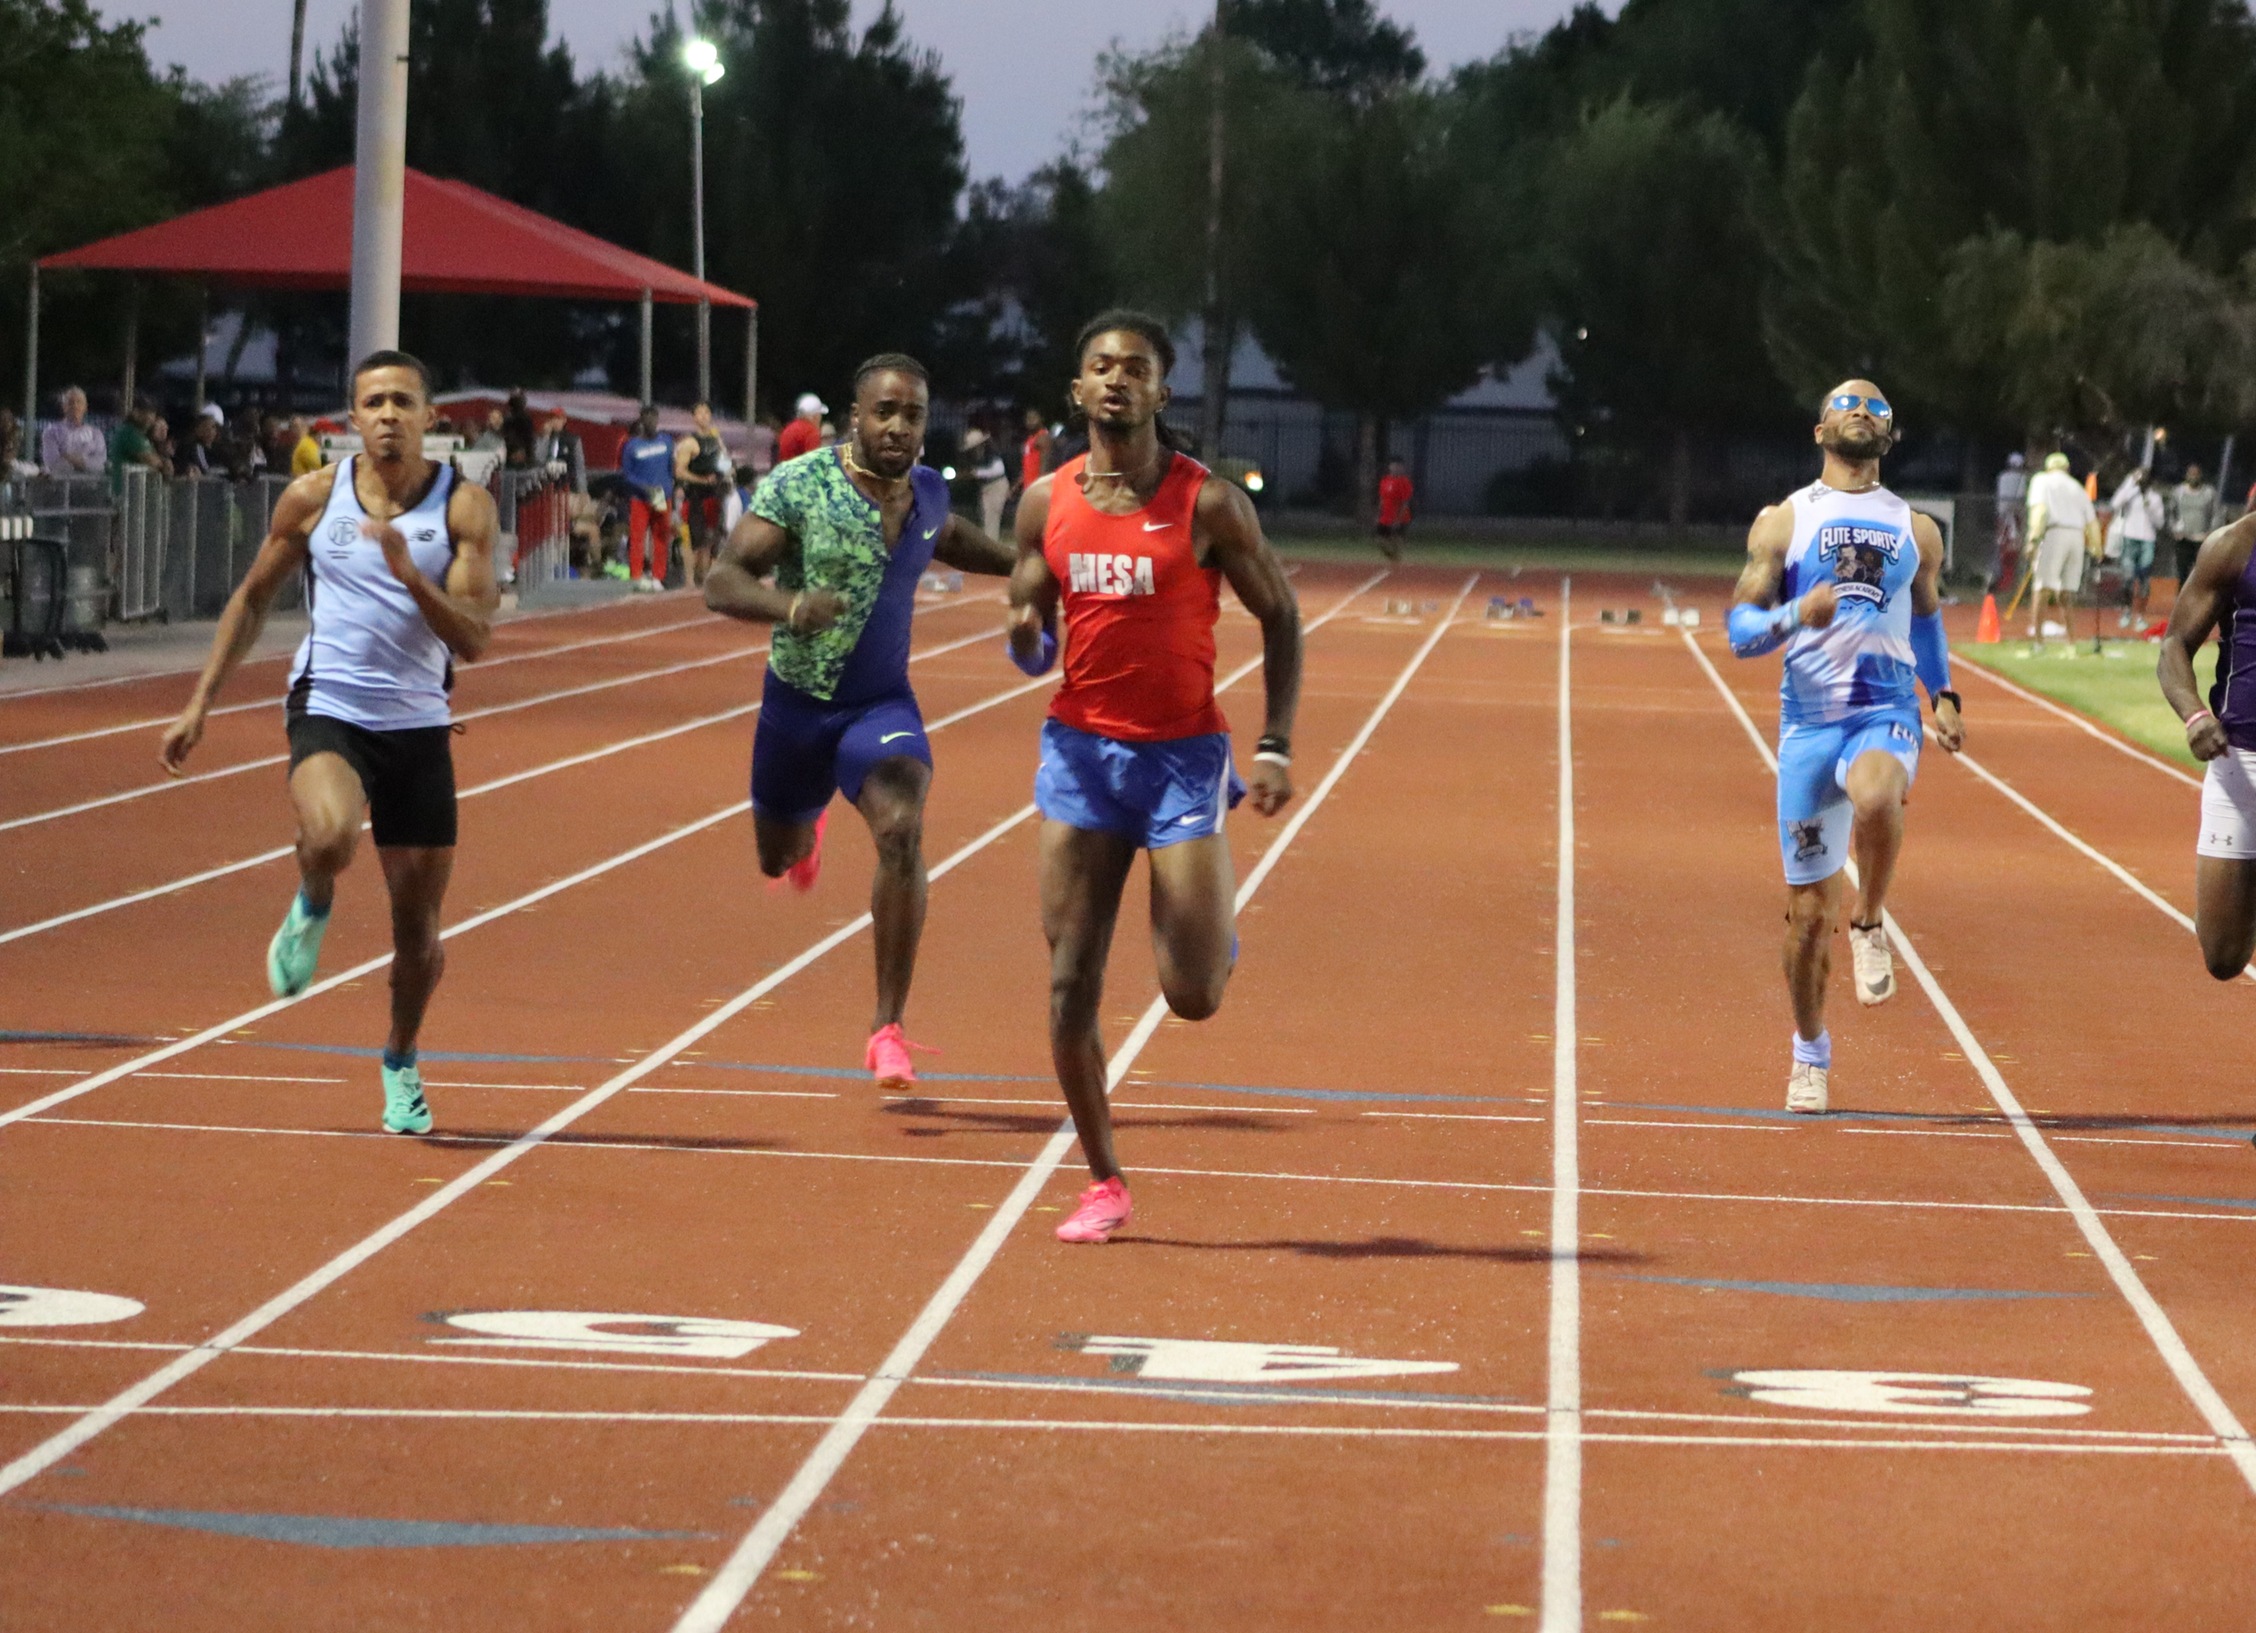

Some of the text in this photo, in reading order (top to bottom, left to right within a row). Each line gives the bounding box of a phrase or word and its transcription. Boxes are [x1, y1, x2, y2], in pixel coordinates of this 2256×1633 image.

[1821, 527, 1899, 561] ELITE SPORTS
[1068, 553, 1156, 596] MESA
[1855, 584, 1881, 599] ACADEMY
